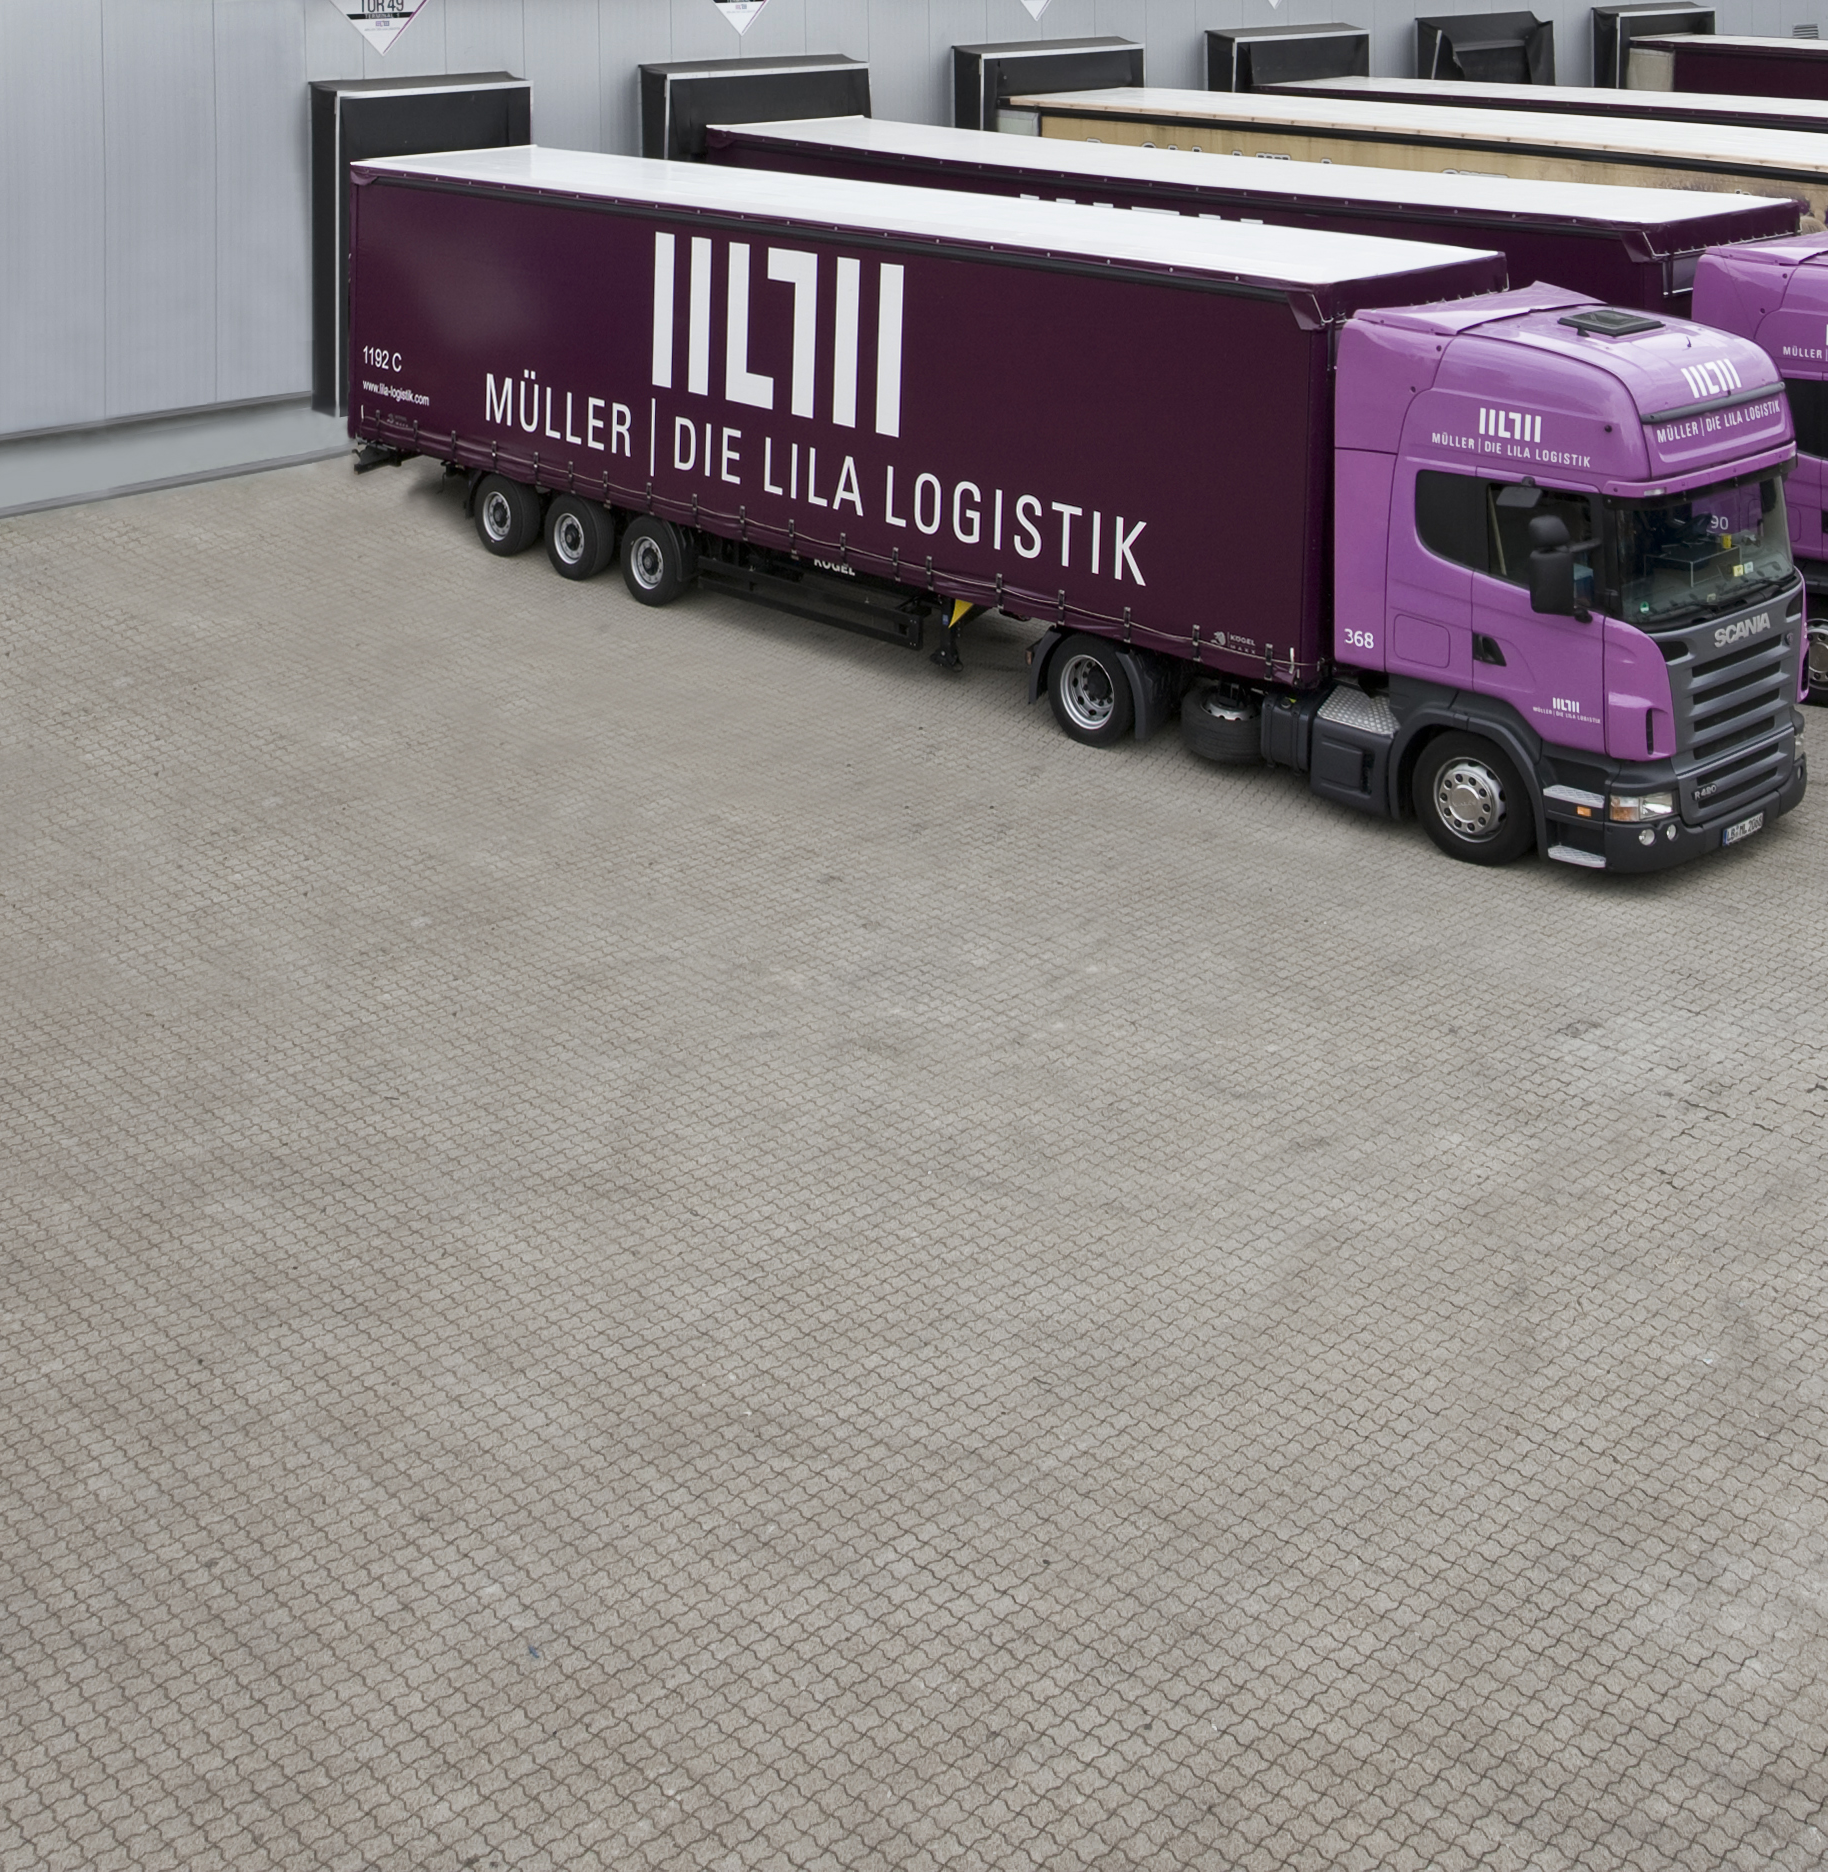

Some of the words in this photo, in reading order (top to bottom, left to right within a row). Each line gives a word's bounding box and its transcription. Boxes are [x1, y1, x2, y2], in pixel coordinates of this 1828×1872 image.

[362, 345, 390, 370] 1192
[392, 352, 402, 373] C
[1782, 345, 1823, 359] MÜLLER
[362, 379, 430, 407] www.lila-logistik.com
[1656, 420, 1699, 443] MÜLLER
[1705, 415, 1722, 432] DIE
[1723, 411, 1744, 428] LILA
[1744, 399, 1781, 422] LOGISTIK
[1431, 431, 1475, 450] MÜLLER
[1484, 440, 1502, 455] DIE
[1507, 444, 1531, 459] LILA
[1535, 448, 1591, 468] LOGISTIK
[485, 368, 632, 458] MÜLLER
[674, 416, 742, 485] DIE
[764, 436, 864, 517] LILA
[885, 465, 1147, 587] LOGISTIK
[1710, 514, 1729, 530] 90
[1344, 628, 1375, 649] 368
[1714, 612, 1771, 648] SCANIA
